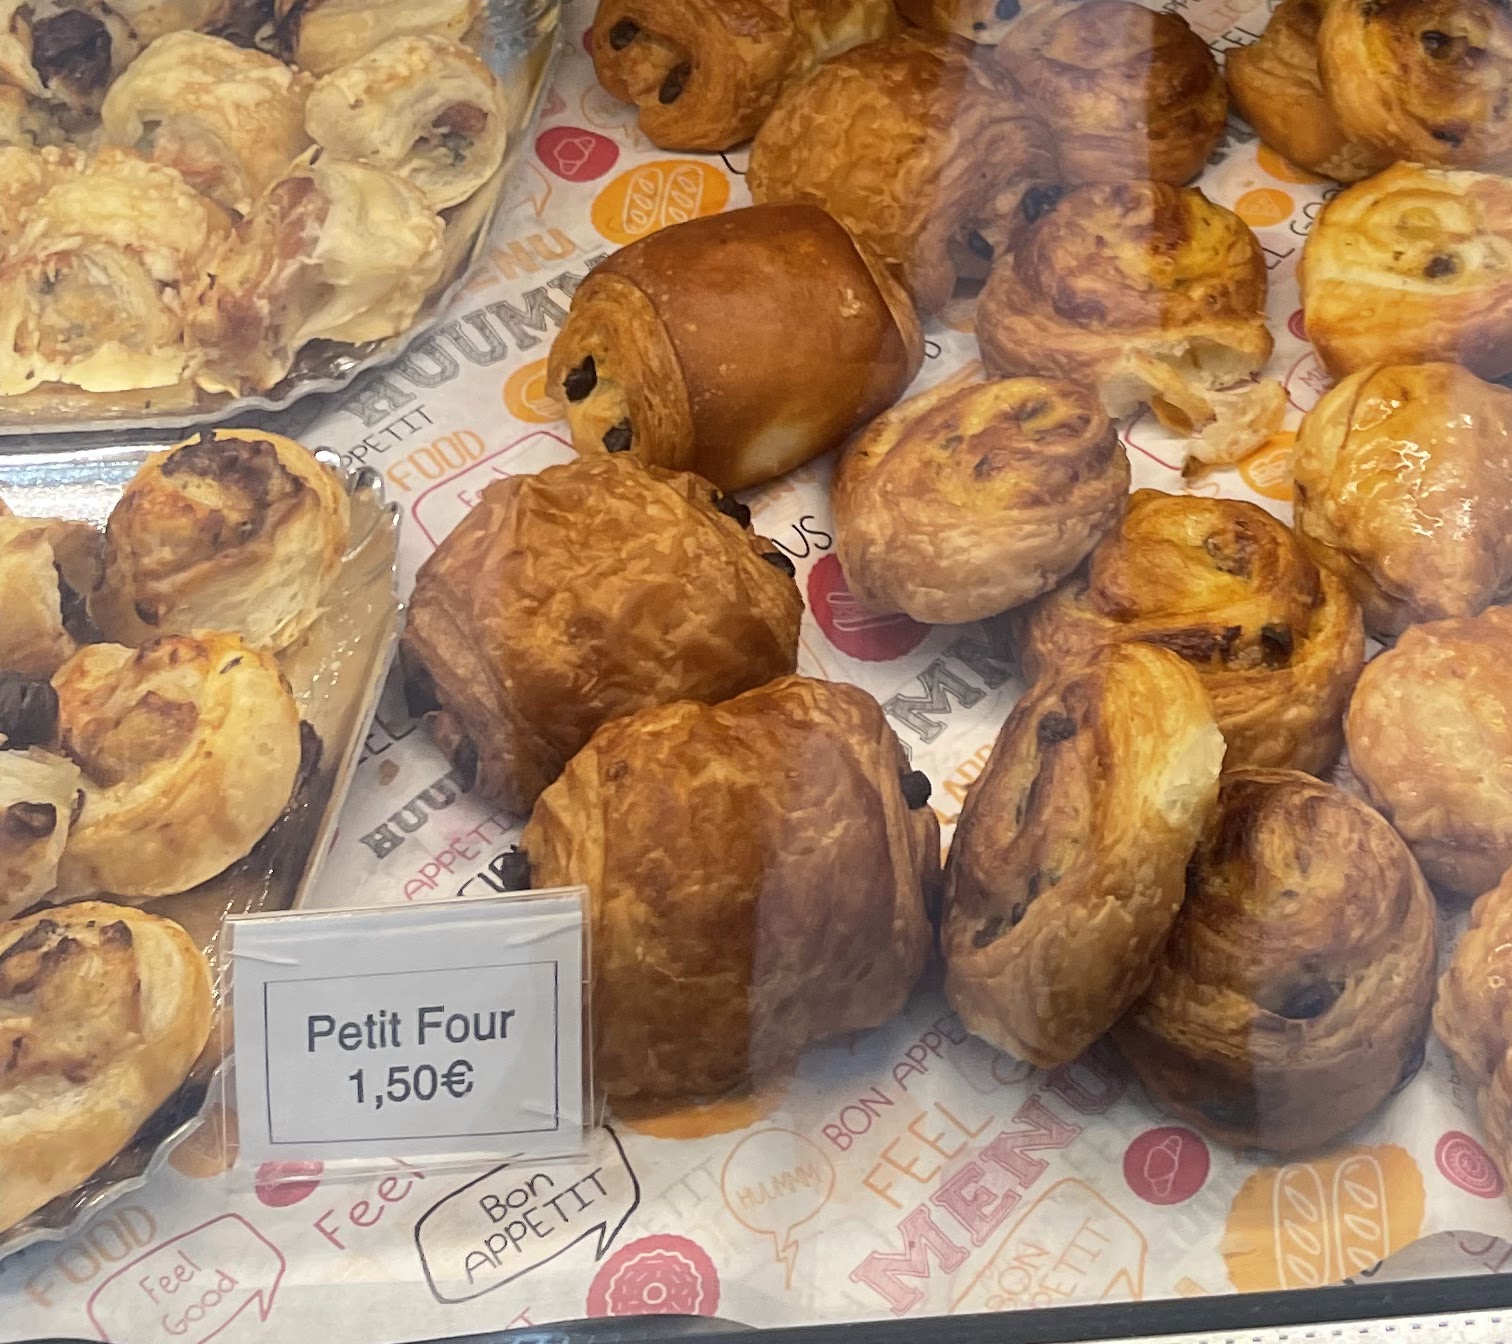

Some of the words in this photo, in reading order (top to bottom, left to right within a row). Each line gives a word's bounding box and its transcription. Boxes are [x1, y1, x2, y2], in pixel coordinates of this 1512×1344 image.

[386, 428, 488, 492] FOOD
[403, 815, 515, 901] APPETI
[308, 1010, 402, 1053] Petit
[418, 1005, 516, 1046] Four
[348, 1059, 475, 1111] 1,50€
[822, 1087, 895, 1151] BON
[892, 1014, 968, 1090] APPE
[478, 1172, 555, 1224] Bon
[849, 1047, 1132, 1317] MENU
[862, 1101, 995, 1209] FEEL
[313, 1156, 426, 1250] Feel
[464, 1167, 608, 1285] APPETIT
[24, 1205, 157, 1308] FOOD
[138, 1249, 202, 1305] Feel
[162, 1268, 239, 1336] Good
